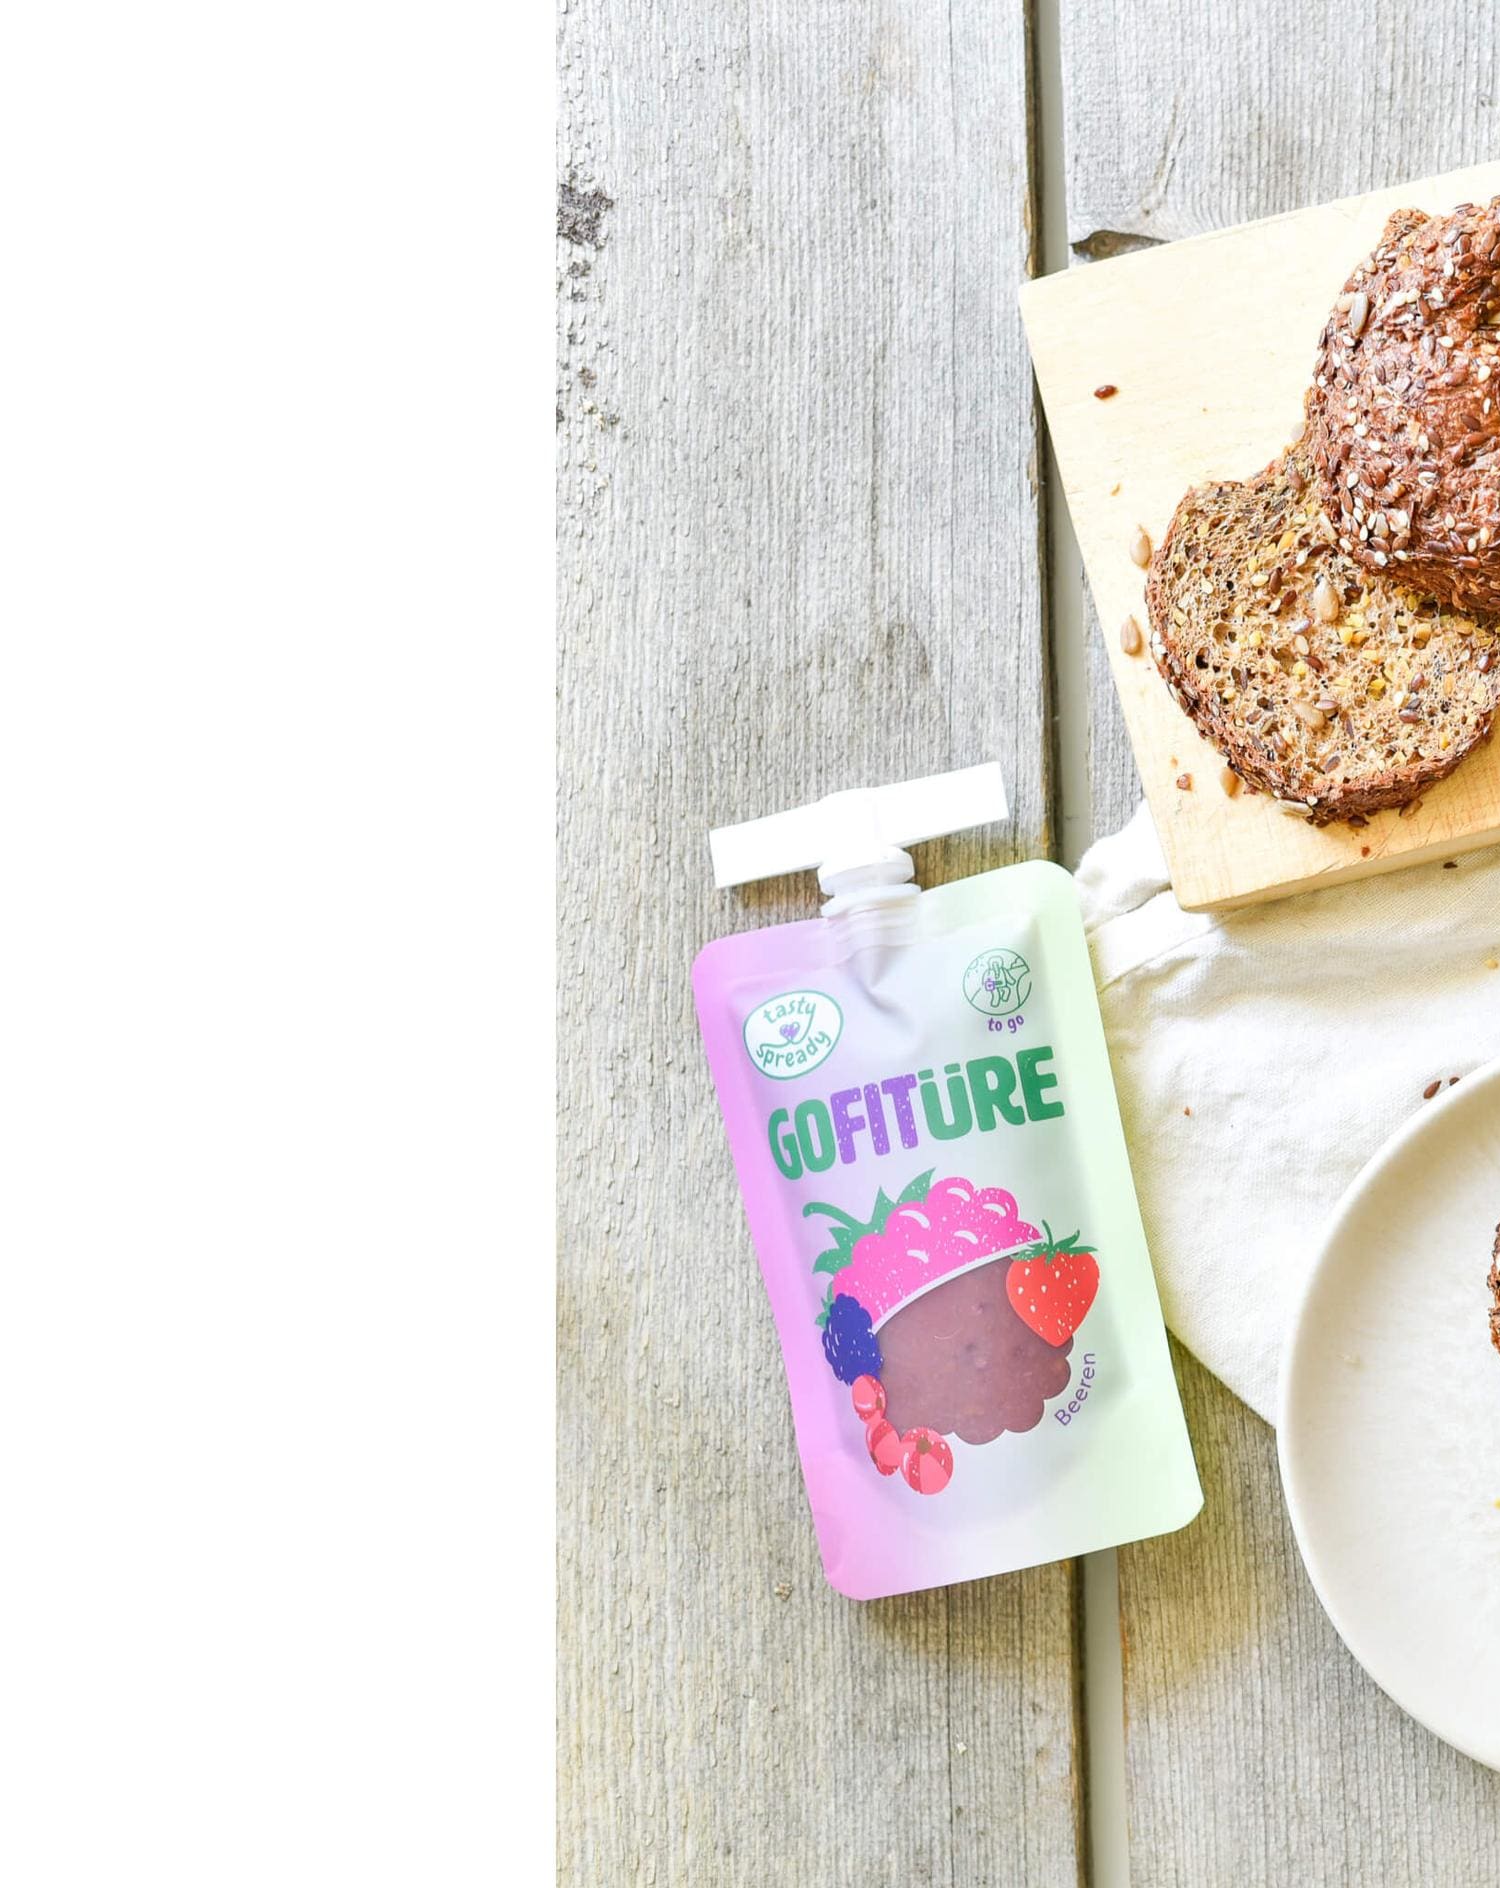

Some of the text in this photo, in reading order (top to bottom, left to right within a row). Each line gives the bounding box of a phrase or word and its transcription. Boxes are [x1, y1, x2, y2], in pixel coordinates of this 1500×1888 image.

[763, 996, 816, 1031] tasty
[988, 1015, 1025, 1034] to go
[756, 1031, 831, 1069] spready
[768, 1046, 1066, 1180] GOFITÜRE
[1054, 1352, 1096, 1426] Beeren
